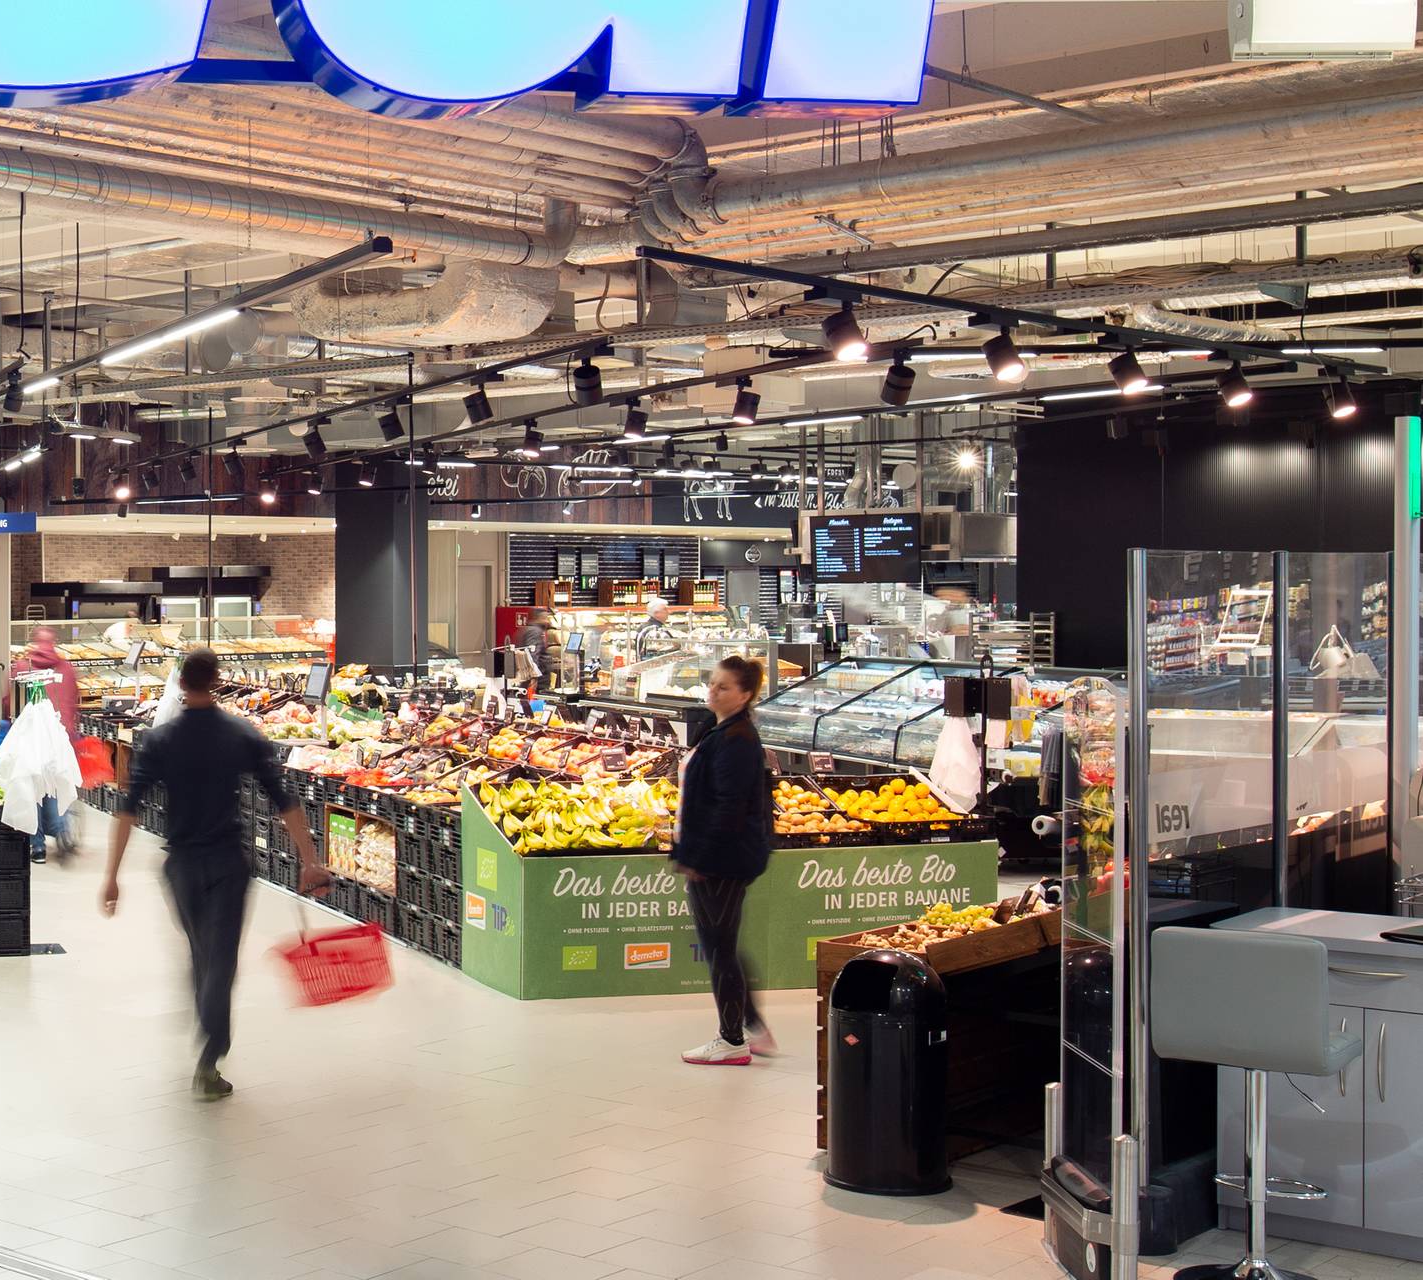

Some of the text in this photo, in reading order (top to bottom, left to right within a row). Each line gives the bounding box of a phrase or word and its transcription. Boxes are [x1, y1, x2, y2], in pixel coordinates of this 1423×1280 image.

[552, 864, 676, 897] Das beste
[798, 854, 956, 890] Das beste Bio
[581, 902, 600, 920] IN
[606, 900, 660, 918] JEDER
[824, 888, 970, 910] IN JEDER BANANE
[630, 950, 664, 962] demeter
